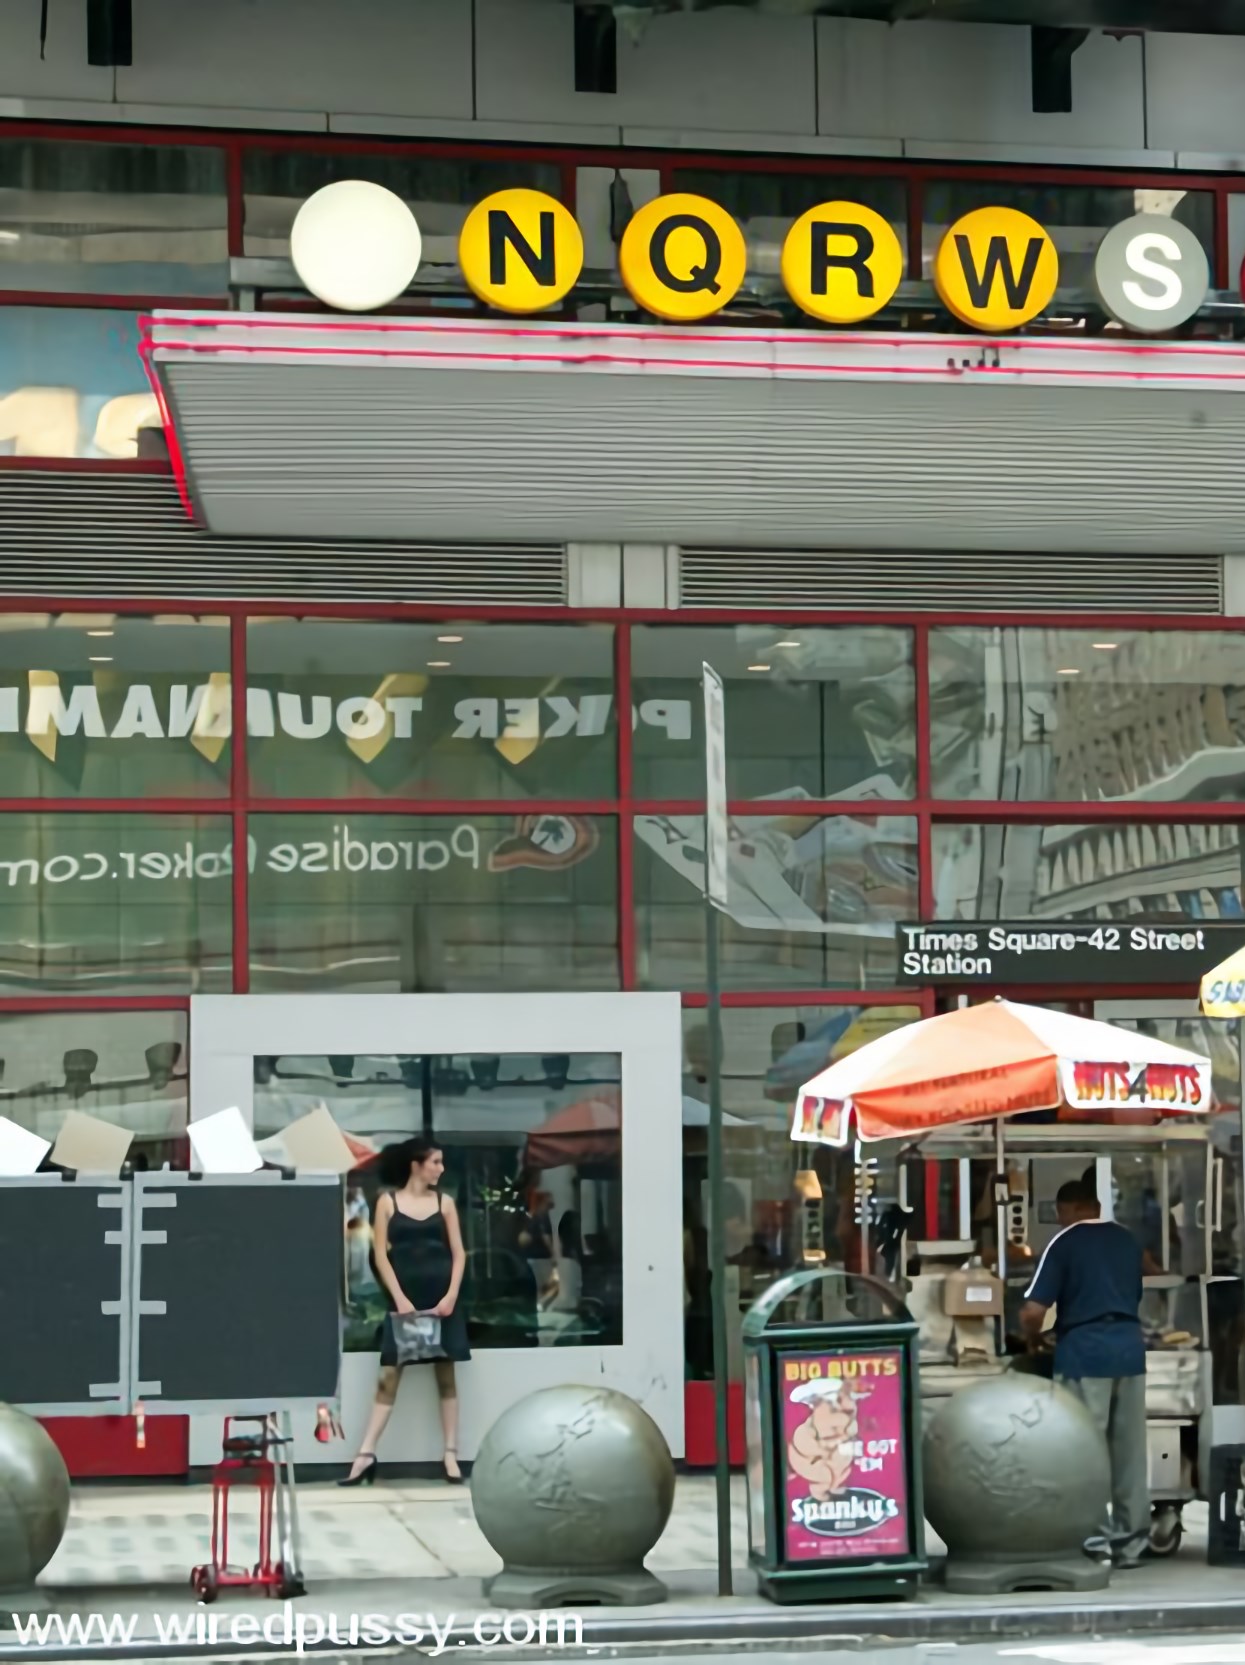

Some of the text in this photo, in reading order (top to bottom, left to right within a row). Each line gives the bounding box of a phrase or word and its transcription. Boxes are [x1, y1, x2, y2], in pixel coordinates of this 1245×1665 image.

[488, 210, 556, 287] N
[648, 214, 721, 295] Q
[810, 221, 874, 298] R
[954, 234, 1045, 310] W
[1121, 232, 1183, 310] S
[902, 926, 1204, 954] Times Square-42 Street
[903, 952, 992, 975] Station
